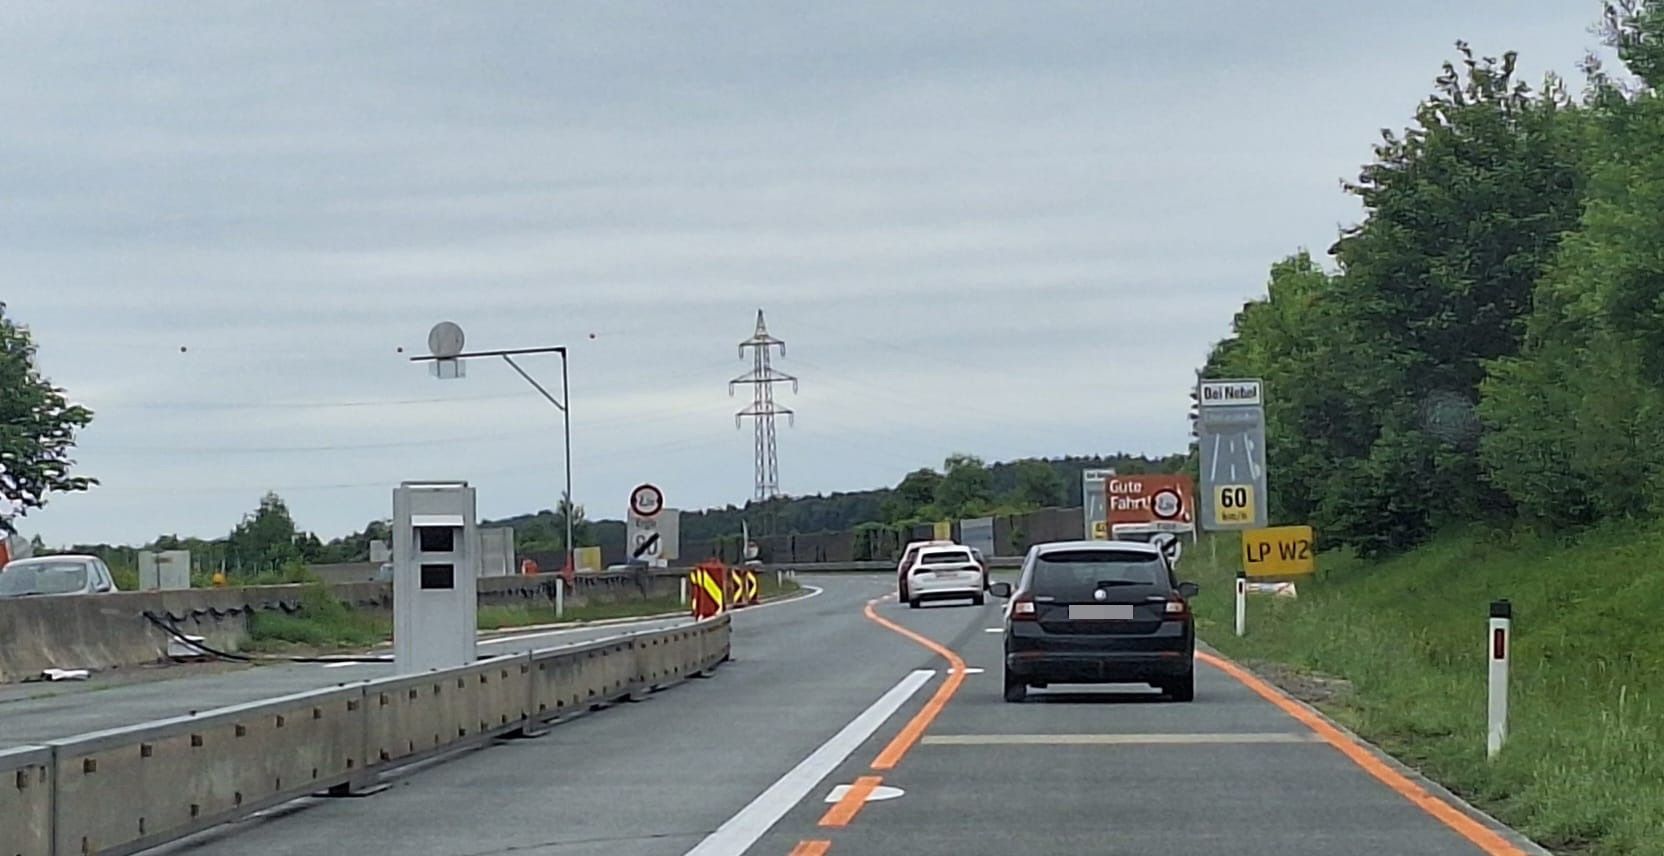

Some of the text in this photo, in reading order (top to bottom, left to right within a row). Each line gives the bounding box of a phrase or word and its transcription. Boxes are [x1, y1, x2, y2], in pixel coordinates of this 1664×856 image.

[1204, 385, 1257, 400] Bei Nebel
[1109, 479, 1142, 494] Gute
[1221, 487, 1247, 508] 60
[1246, 539, 1309, 563] LP W2
